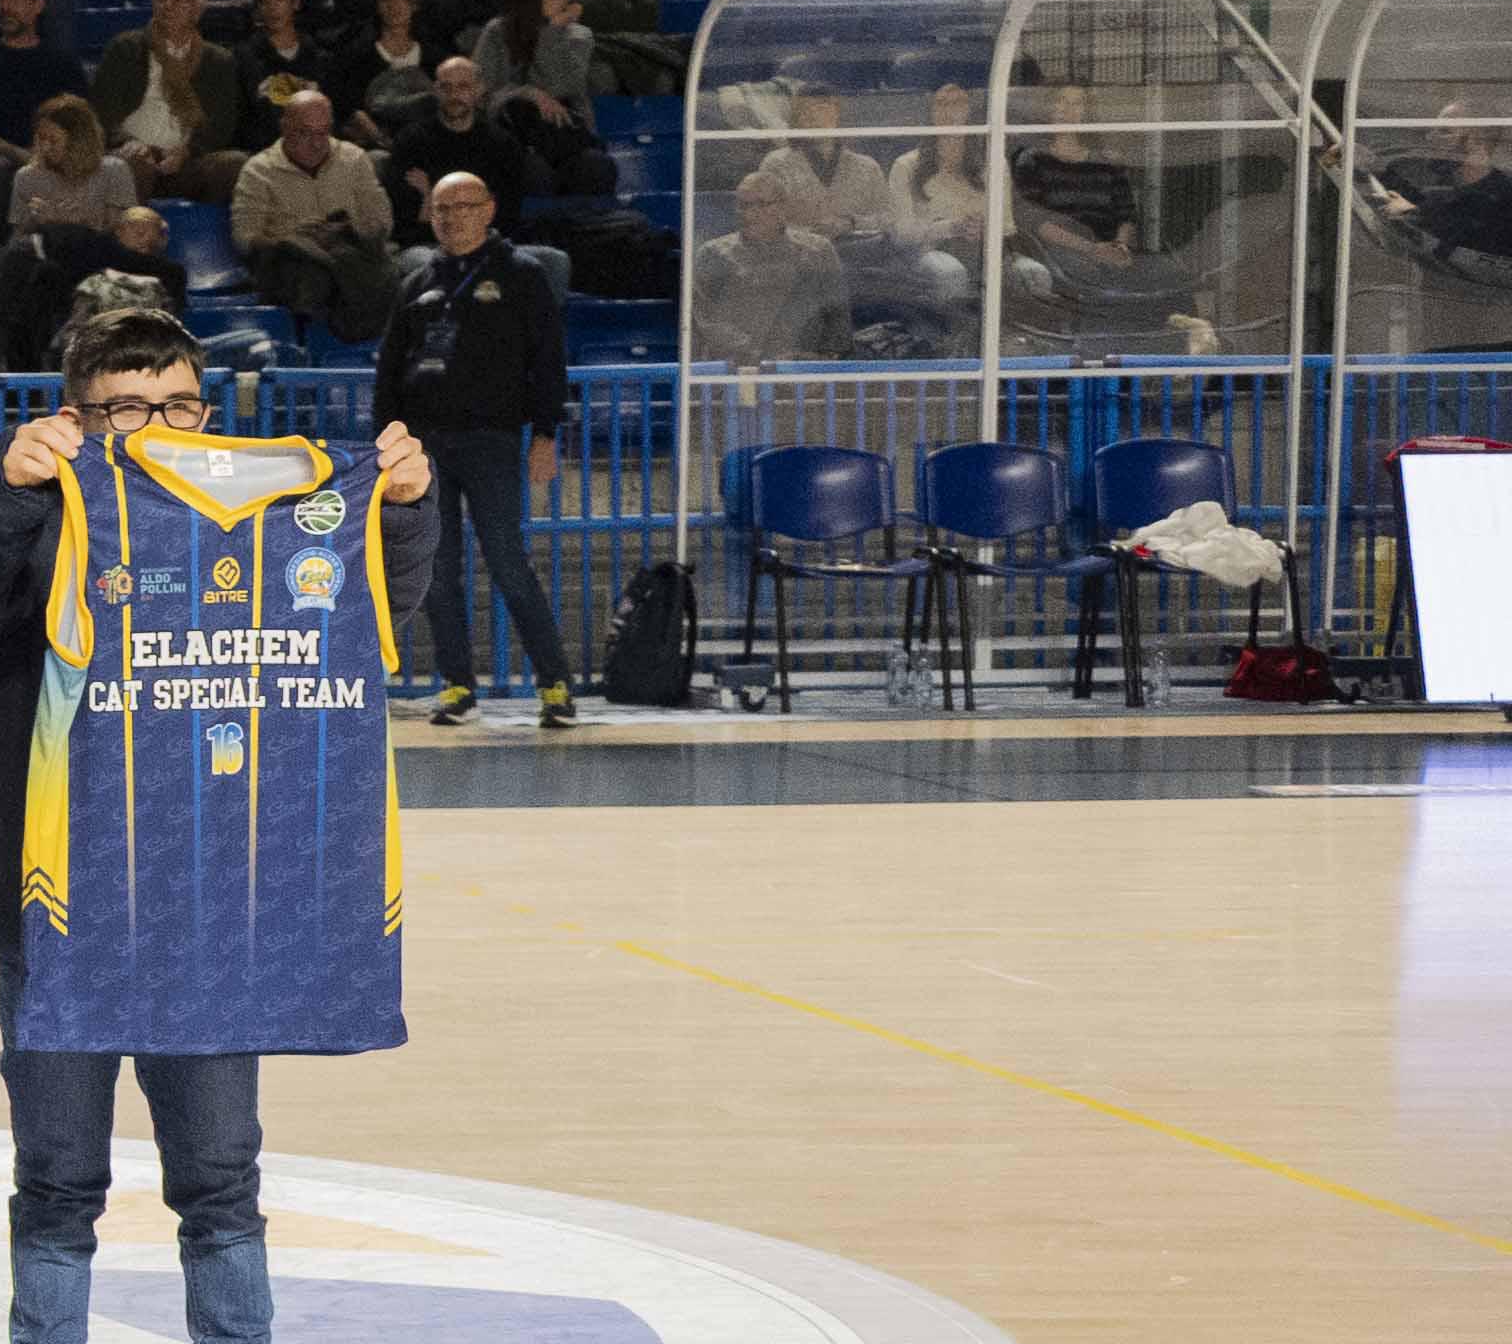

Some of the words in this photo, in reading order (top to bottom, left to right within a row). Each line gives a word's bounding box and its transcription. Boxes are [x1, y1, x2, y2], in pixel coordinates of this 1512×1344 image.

[139, 574, 171, 584] ALDO
[140, 582, 187, 594] POLLINI
[202, 589, 249, 604] BITRE
[130, 629, 321, 668] ELACHEM
[88, 680, 144, 712] CAT
[153, 677, 267, 710] SPECIAL
[276, 678, 366, 709] TEAM
